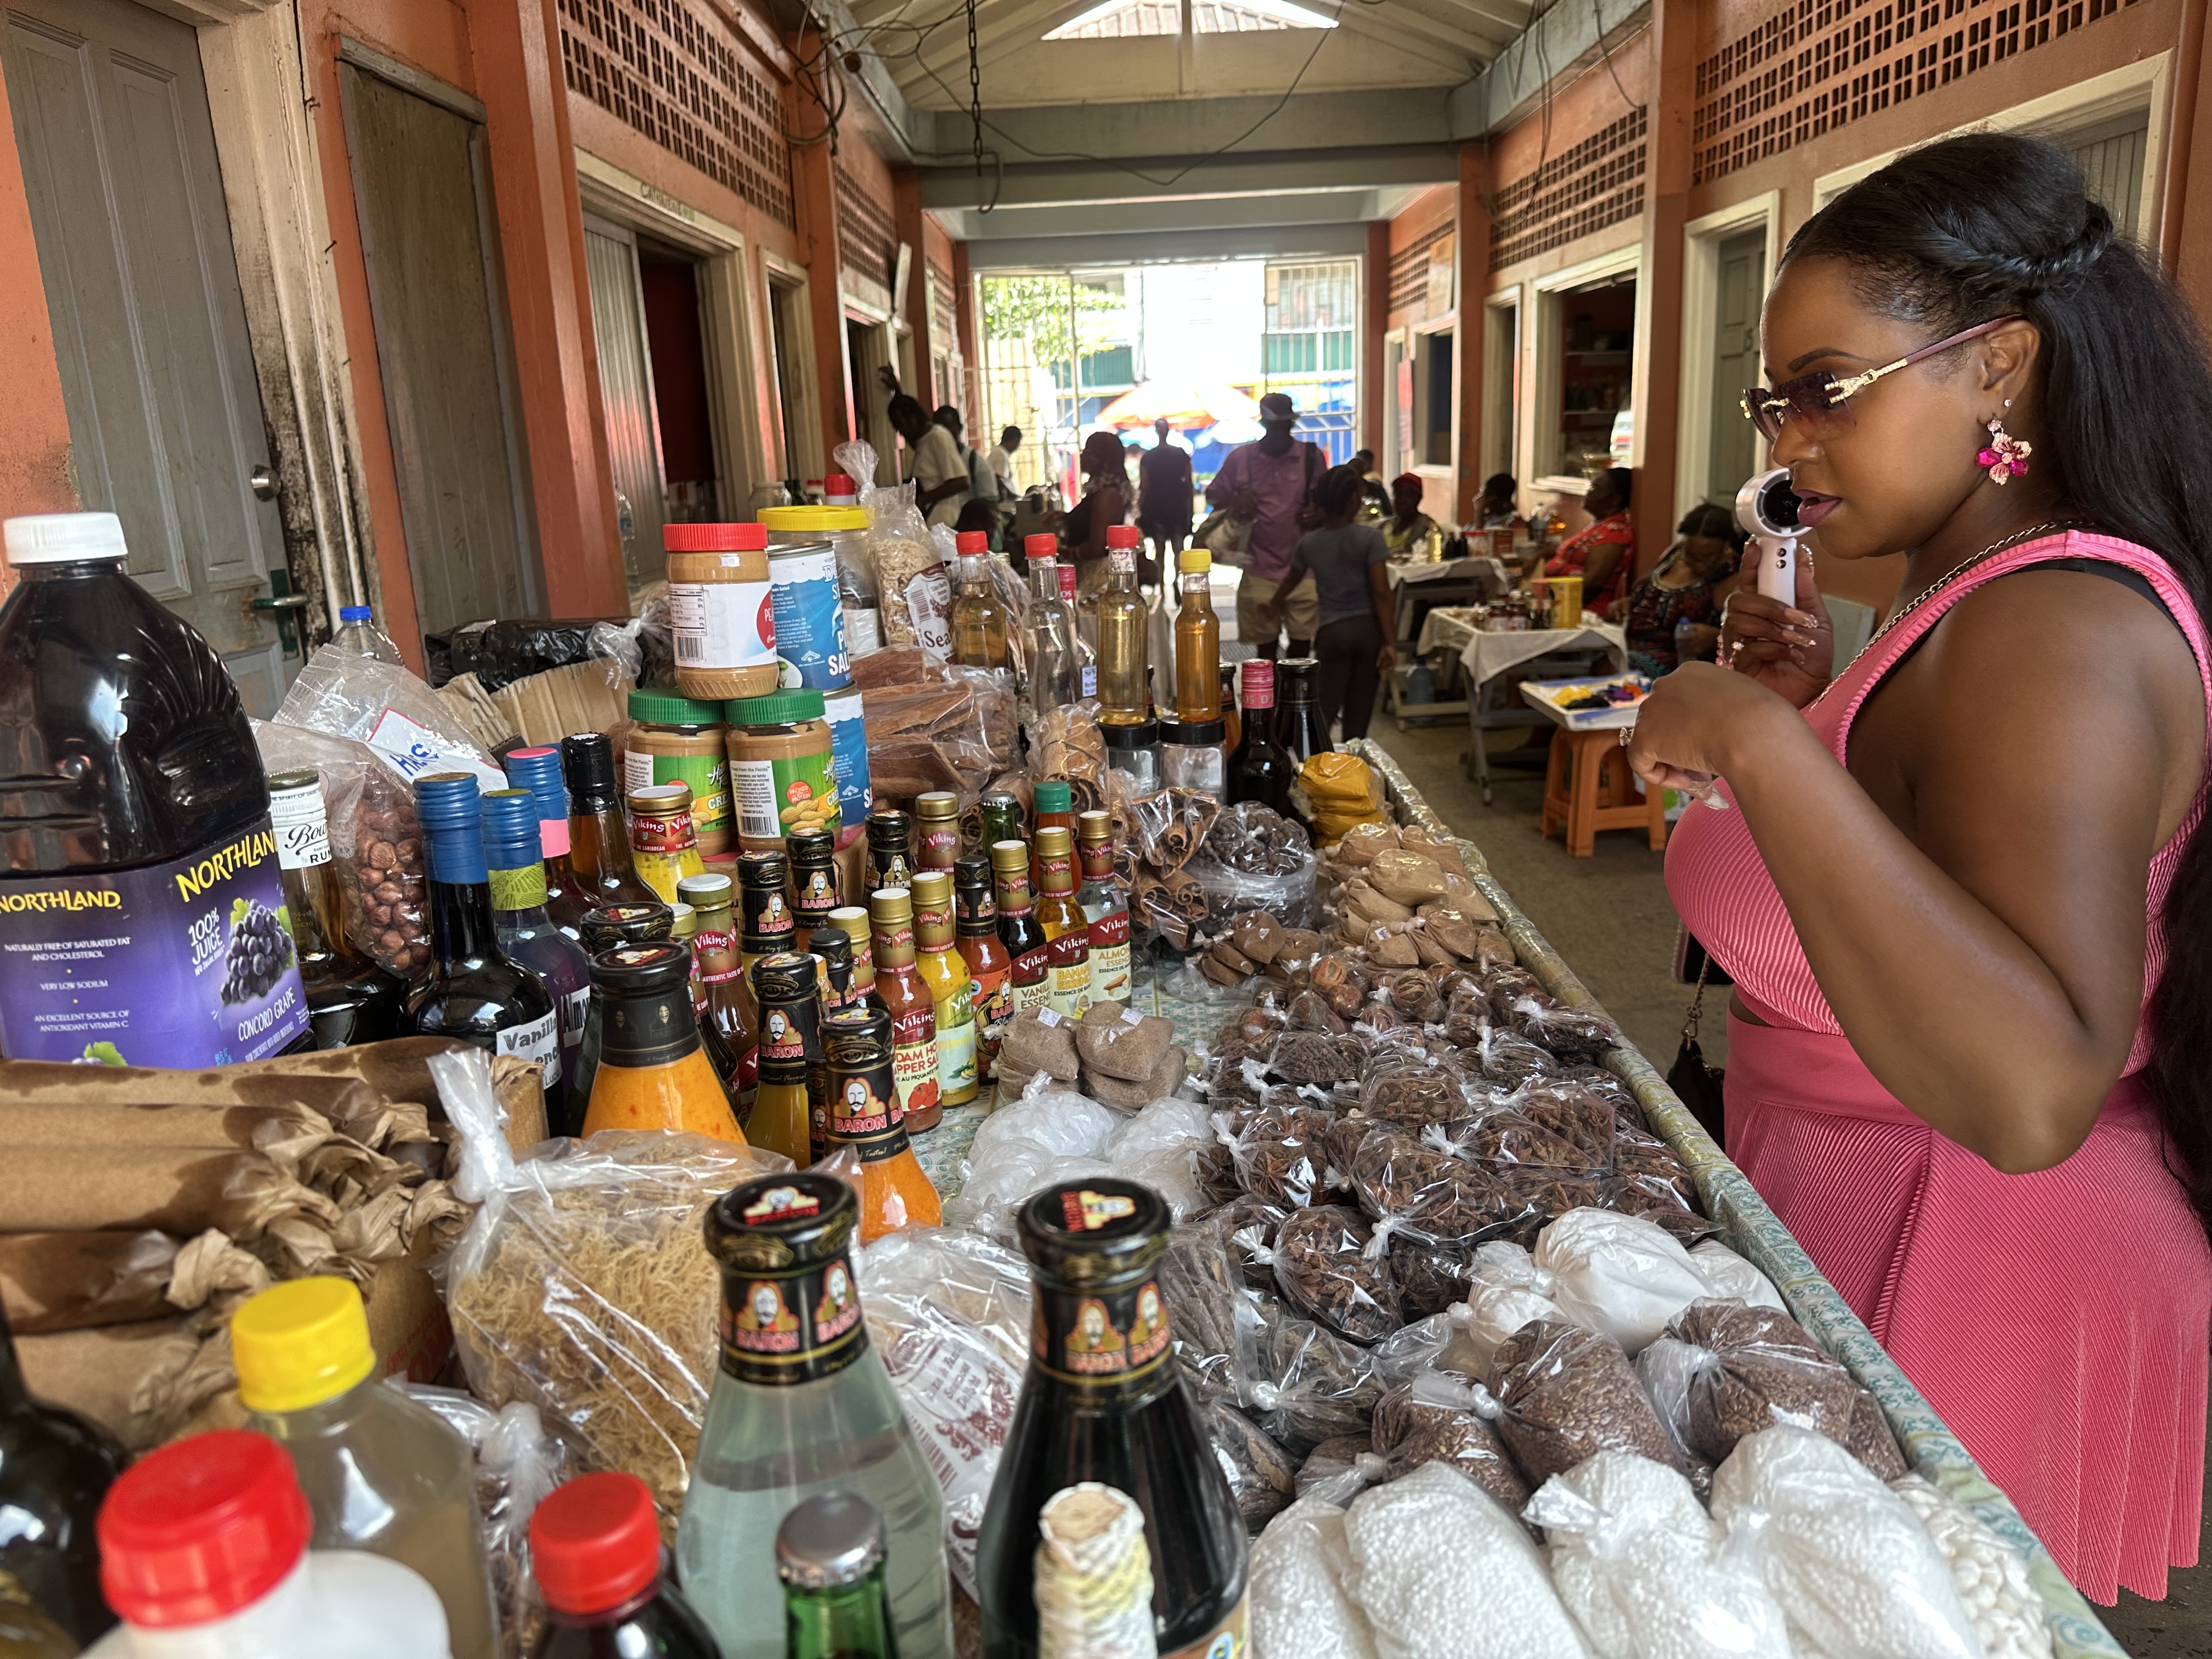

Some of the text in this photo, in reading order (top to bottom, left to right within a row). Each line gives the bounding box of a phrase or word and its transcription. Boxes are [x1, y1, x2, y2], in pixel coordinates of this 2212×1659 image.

[789, 785, 809, 795] PACKED
[634, 819, 665, 833] Viking
[929, 833, 956, 847] Viking
[802, 895, 835, 909] BARON
[918, 913, 943, 923] Viking
[759, 919, 793, 933] BARON
[192, 927, 223, 965] JUICE
[694, 933, 728, 950] Viking
[703, 973, 726, 983] AUTHENTIC
[726, 970, 737, 979] TASTE
[238, 1007, 273, 1042] CONCORD
[274, 986, 296, 1019] GRAPE
[894, 1012, 935, 1032] Viking
[760, 1044, 804, 1058] BARON
[833, 1114, 887, 1133] BARON
[737, 1328, 799, 1352] BARON
[1065, 1350, 1126, 1373] BARON
